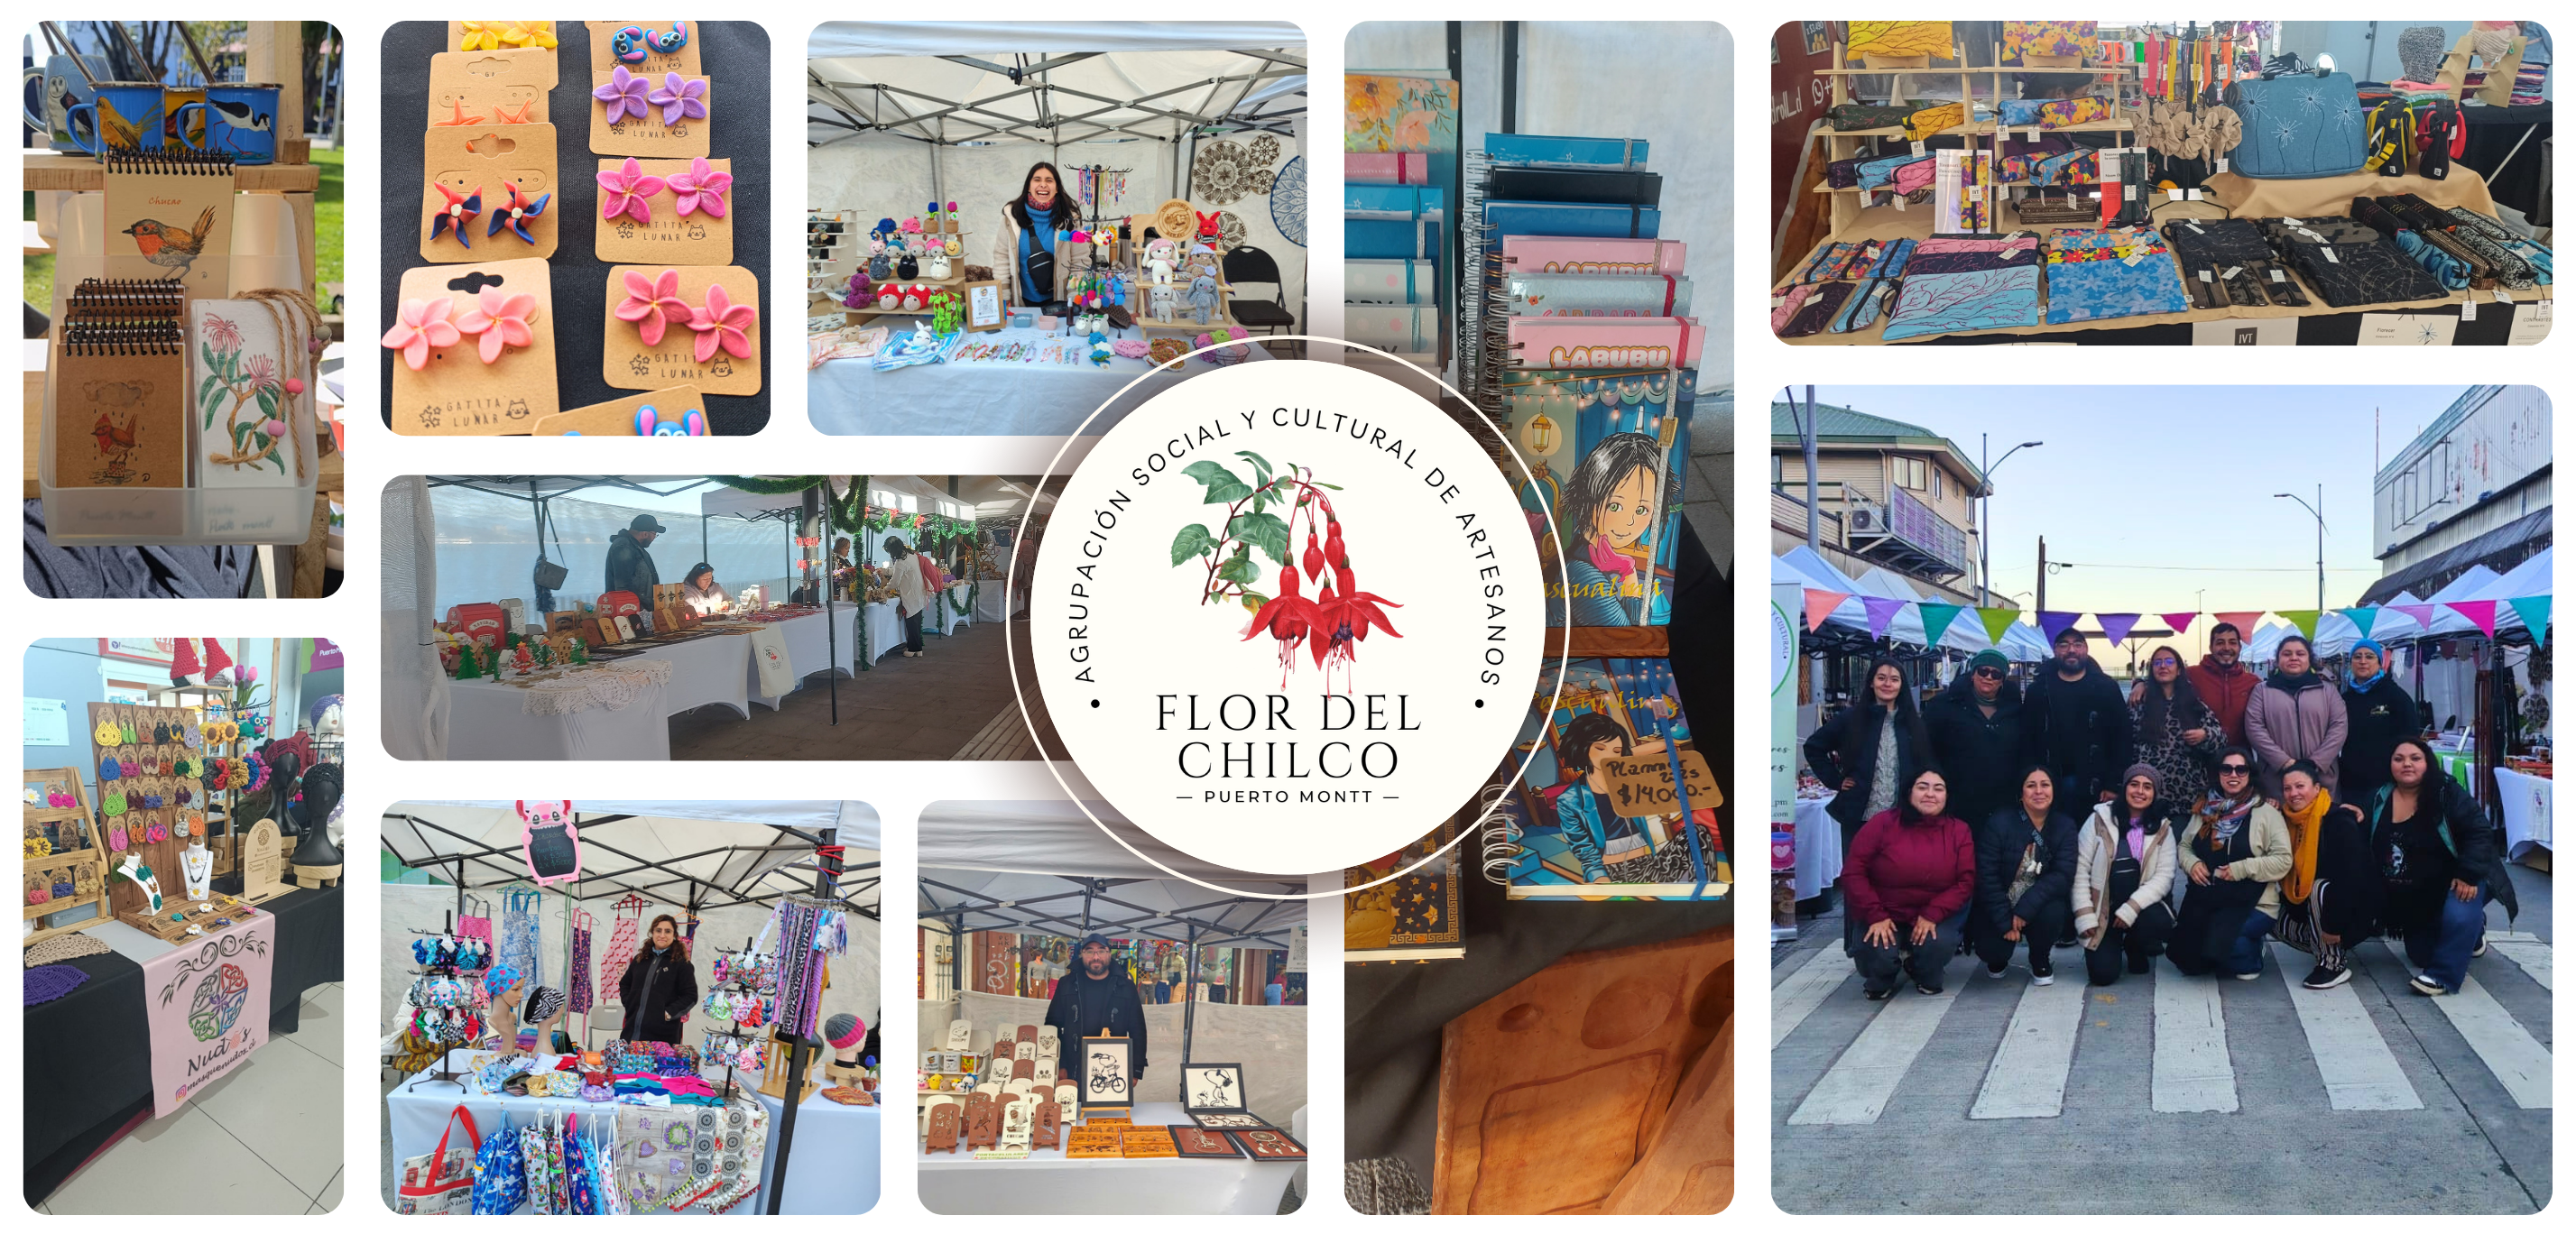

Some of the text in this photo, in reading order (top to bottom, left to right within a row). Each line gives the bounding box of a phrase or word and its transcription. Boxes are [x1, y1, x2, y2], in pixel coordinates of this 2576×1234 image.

[633, 130, 666, 138] LUNAR
[148, 195, 181, 206] Chucao
[638, 221, 683, 229] GATITA
[643, 233, 680, 242] LUNAR
[2239, 333, 2254, 345] IVT
[1549, 345, 1671, 368] LABUBU
[661, 368, 704, 379] LUNAR
[447, 398, 501, 412] GATITA
[453, 413, 499, 427] LUNAR
[188, 1027, 252, 1077] Nuds
